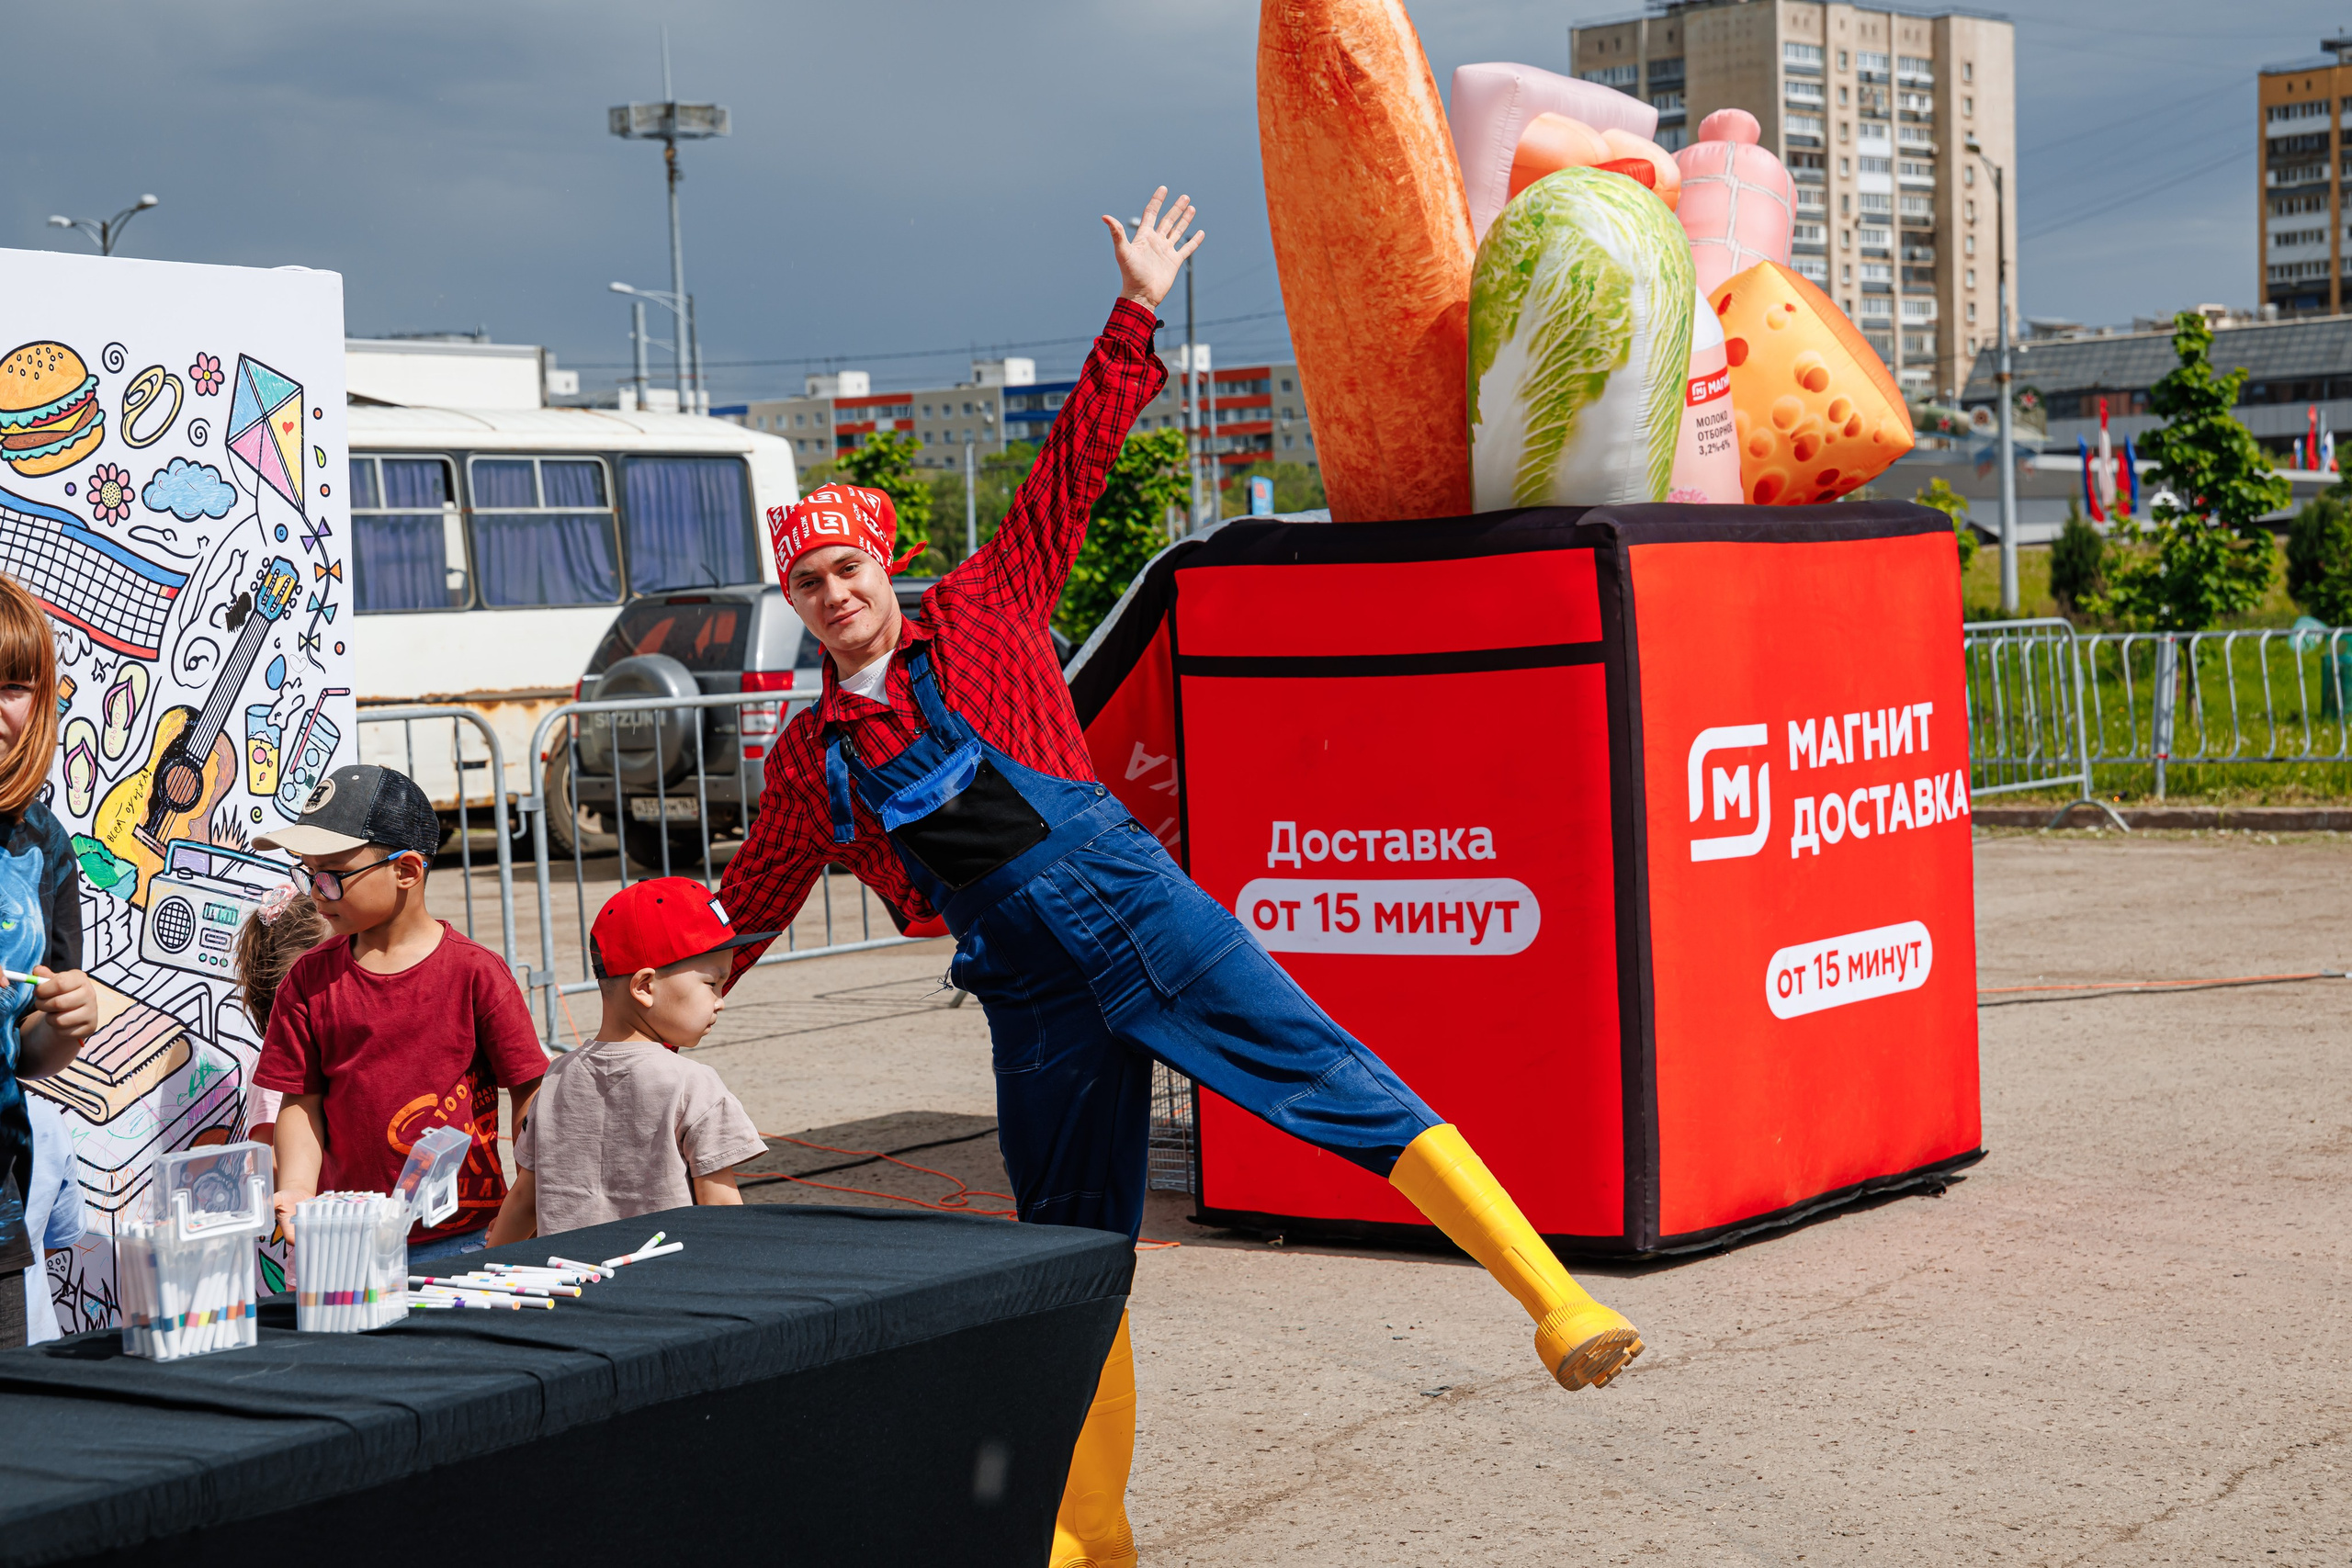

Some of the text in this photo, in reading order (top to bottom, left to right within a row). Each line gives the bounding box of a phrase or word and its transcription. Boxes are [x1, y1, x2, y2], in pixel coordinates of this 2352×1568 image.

[1696, 411, 1727, 428] МОЛОКО
[1698, 422, 1733, 442] ОТБОРНОЕ
[791, 525, 802, 550] ЭКСТРА
[800, 514, 810, 539] ЭКСТРА
[1787, 701, 1934, 772] МАГНИТ
[1790, 768, 1970, 860] ДОСТАВКА
[1267, 820, 1497, 869] Доставка
[1252, 892, 1521, 946] от 15 минут
[1777, 941, 1923, 998] от 15 минут
